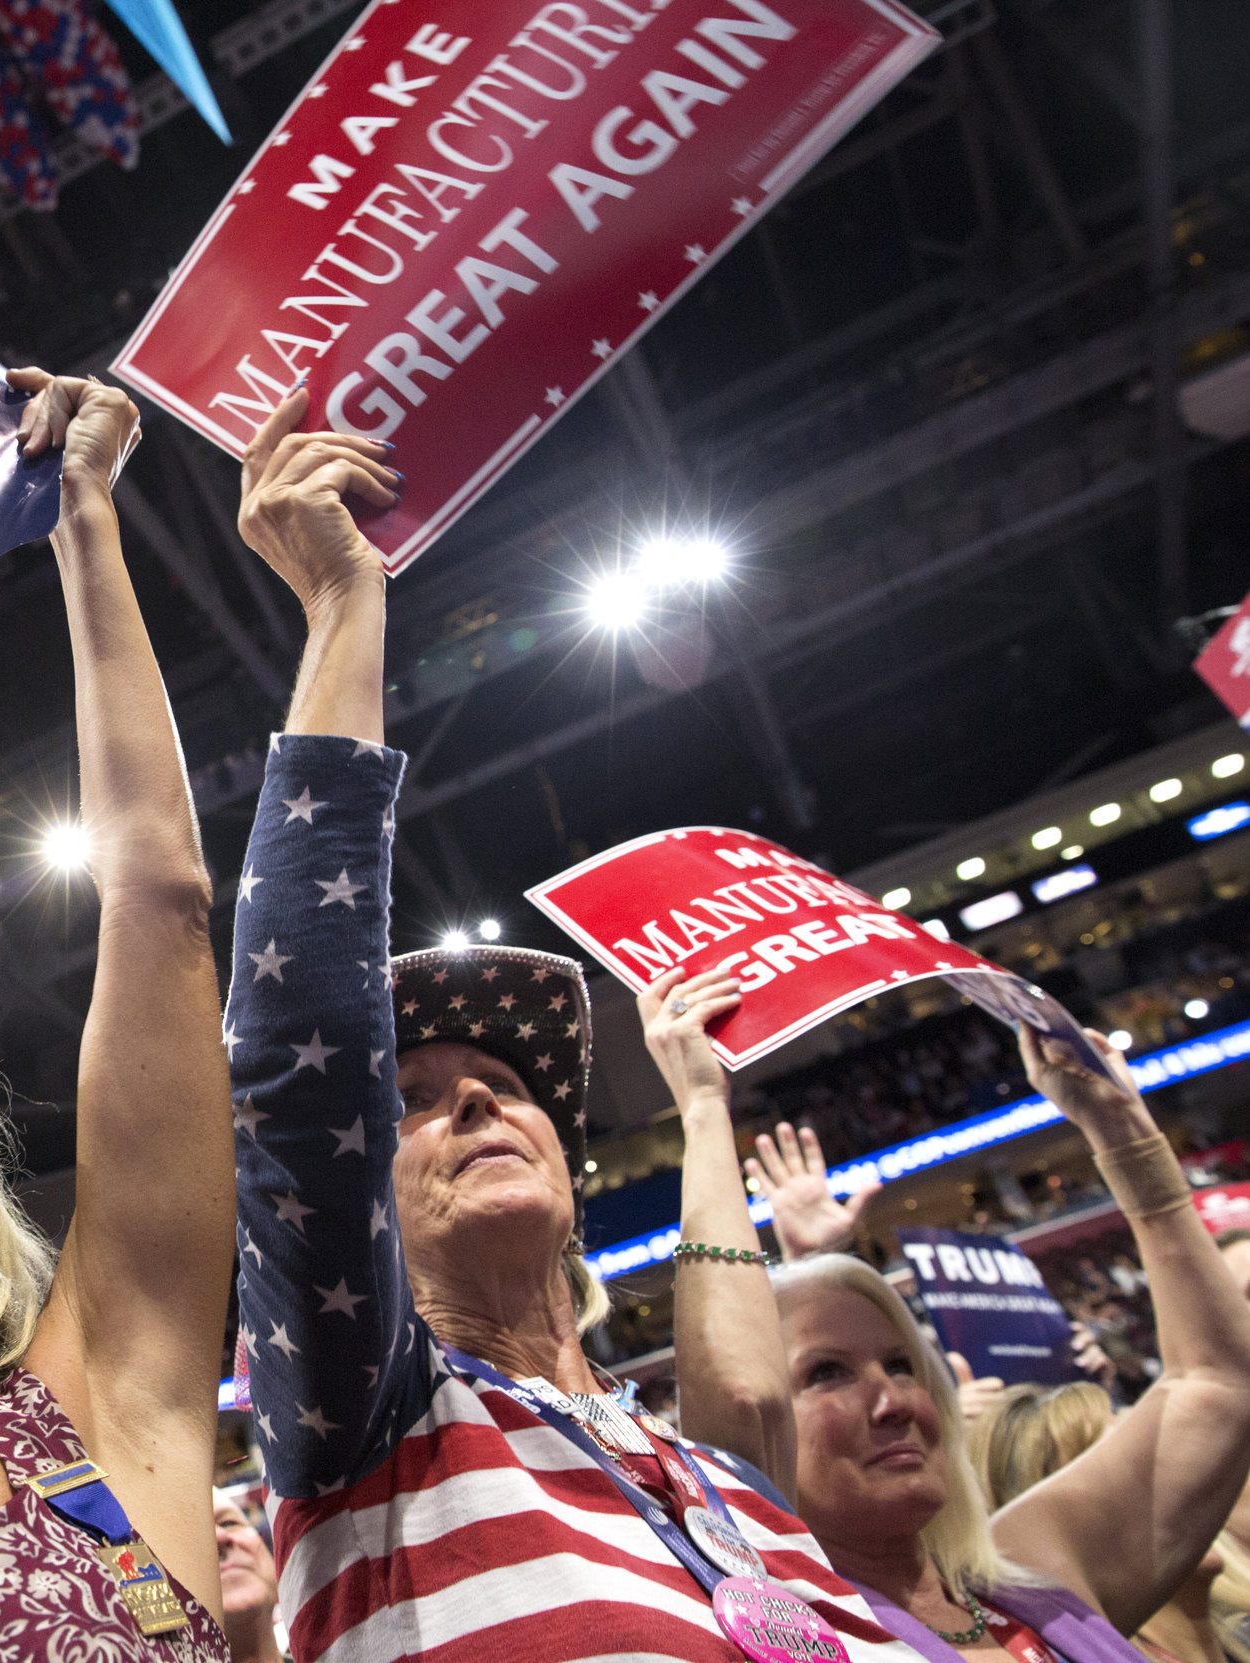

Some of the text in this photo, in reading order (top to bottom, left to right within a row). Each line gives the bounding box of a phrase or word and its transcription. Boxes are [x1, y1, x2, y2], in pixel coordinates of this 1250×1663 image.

[288, 22, 472, 210] MAKE
[208, 0, 671, 434] MANUFACTURI
[325, 207, 559, 441] GREAT
[549, 0, 799, 233] AGAIN
[716, 912, 918, 994] GREAT
[706, 1532, 760, 1567] TRUMP
[721, 1588, 819, 1619] HOT CHICKS
[761, 1605, 795, 1624] FOR
[744, 1625, 839, 1660] TRUMP
